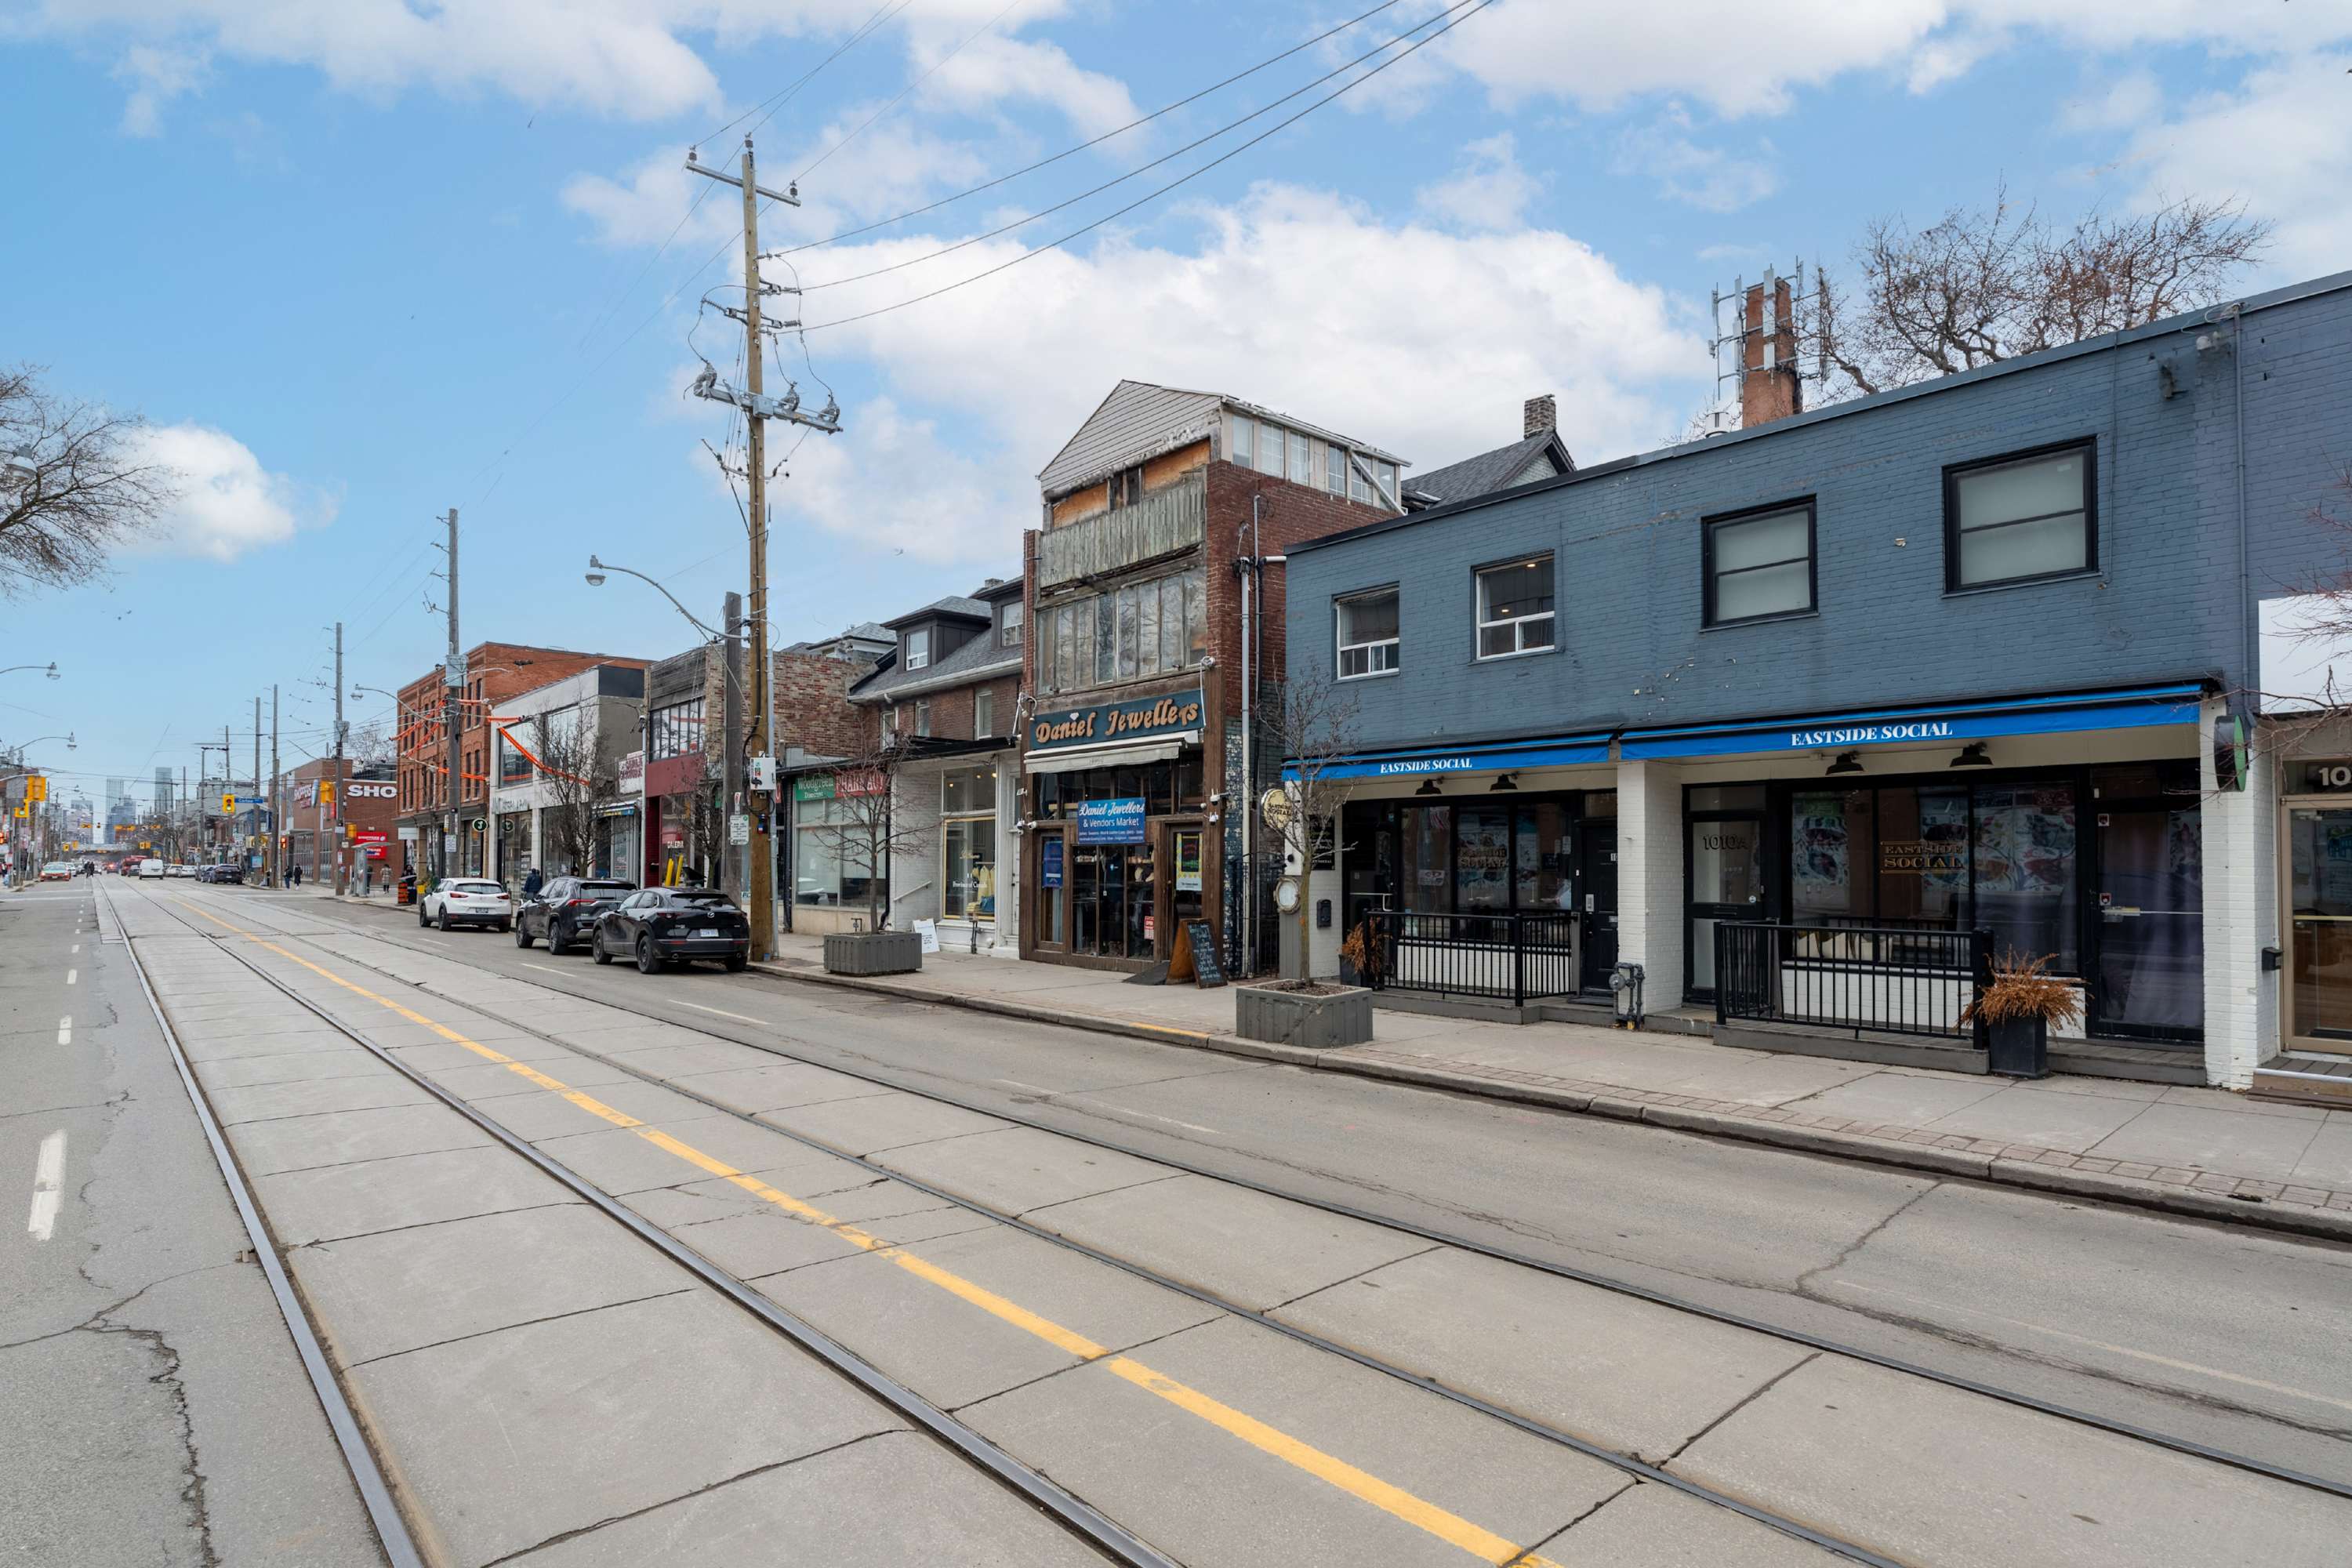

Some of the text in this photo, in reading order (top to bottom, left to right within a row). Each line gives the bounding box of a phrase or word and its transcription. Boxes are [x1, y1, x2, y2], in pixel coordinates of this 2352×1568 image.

[1035, 699, 1199, 743] Daniel Jewellers
[1792, 722, 1953, 746] EASTSIDE SOCIAL
[1381, 758, 1472, 774] EASTSIDE SOCIAL
[797, 775, 834, 791] Woodgreen
[1079, 801, 1145, 816] Daniel Jewellers
[1091, 818, 1115, 827] Vendors
[1116, 816, 1139, 826] Market
[1703, 834, 1748, 851] 1010A
[1884, 856, 1964, 868] SOCIAL
